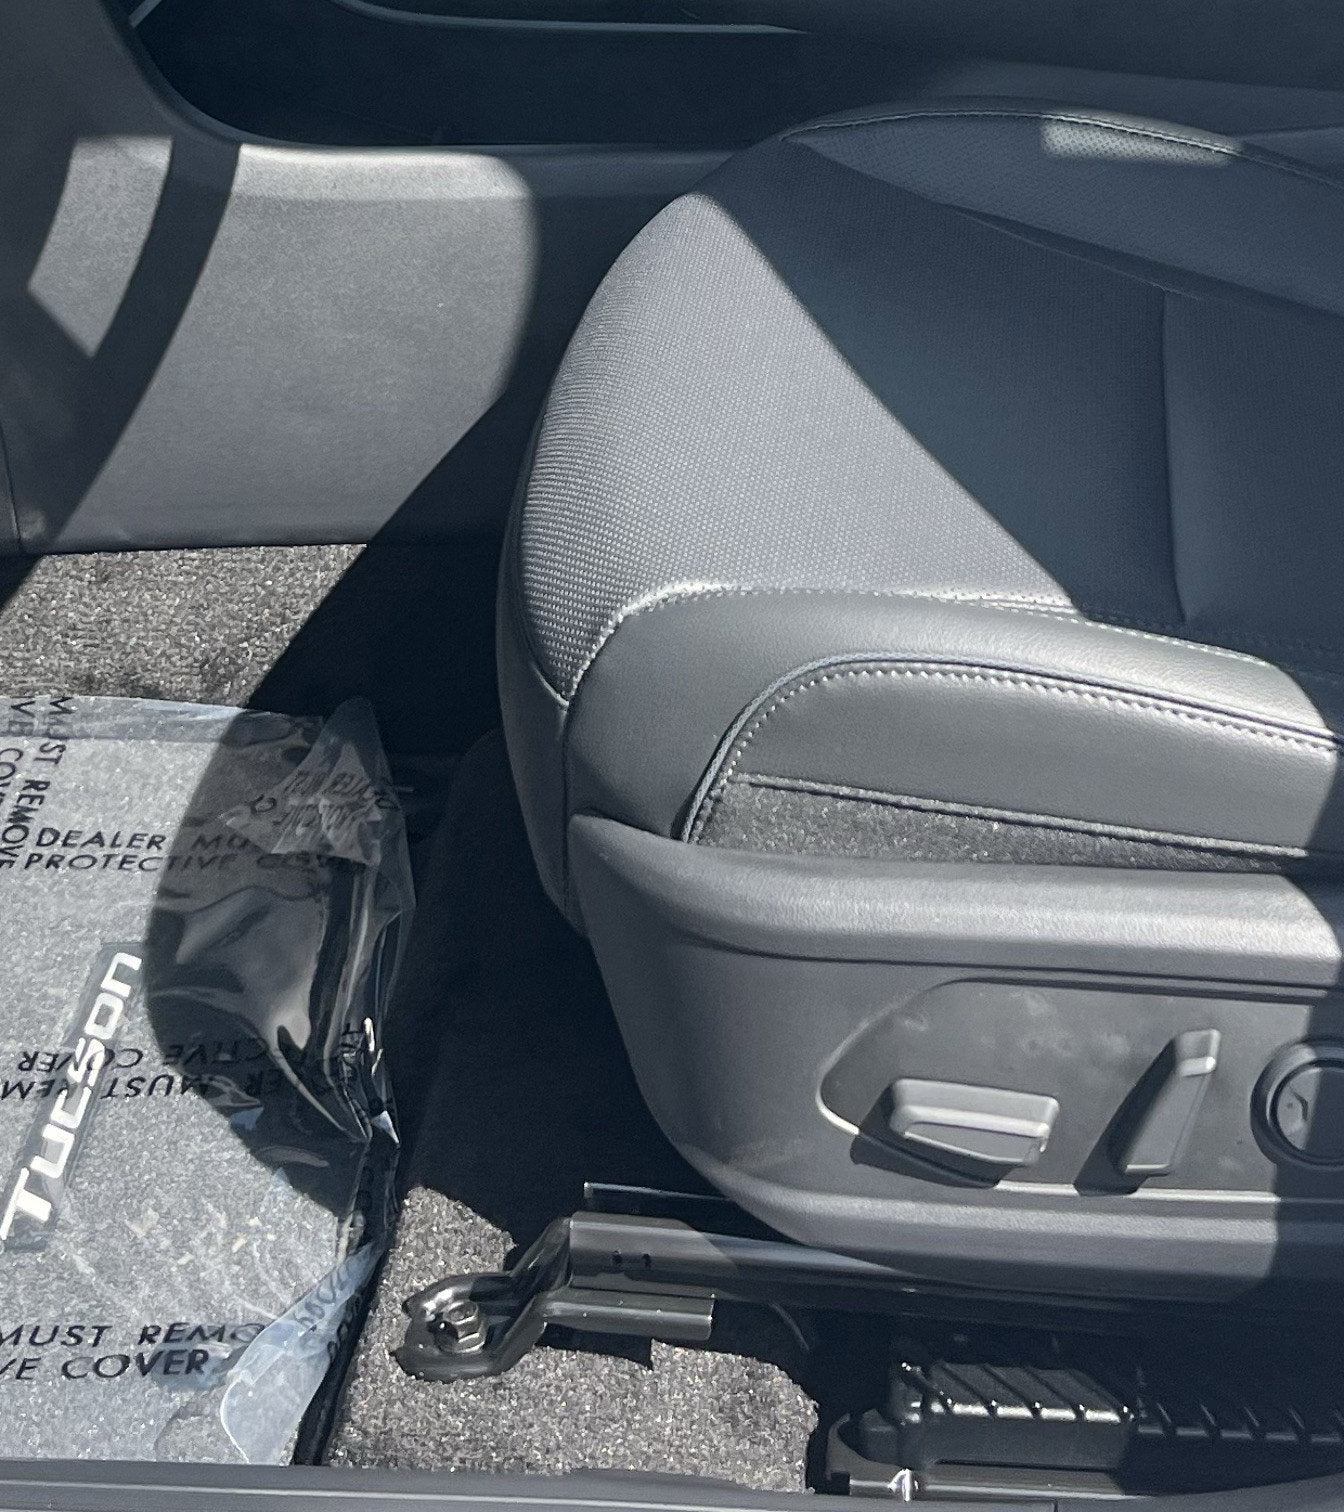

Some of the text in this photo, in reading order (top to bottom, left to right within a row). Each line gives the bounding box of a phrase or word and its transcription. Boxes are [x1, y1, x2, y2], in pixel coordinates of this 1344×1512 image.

[36, 827, 167, 851] DEALER
[24, 852, 239, 872] PROTECTIVE
[137, 1321, 266, 1347] REMO
[60, 1348, 211, 1381] COVER
